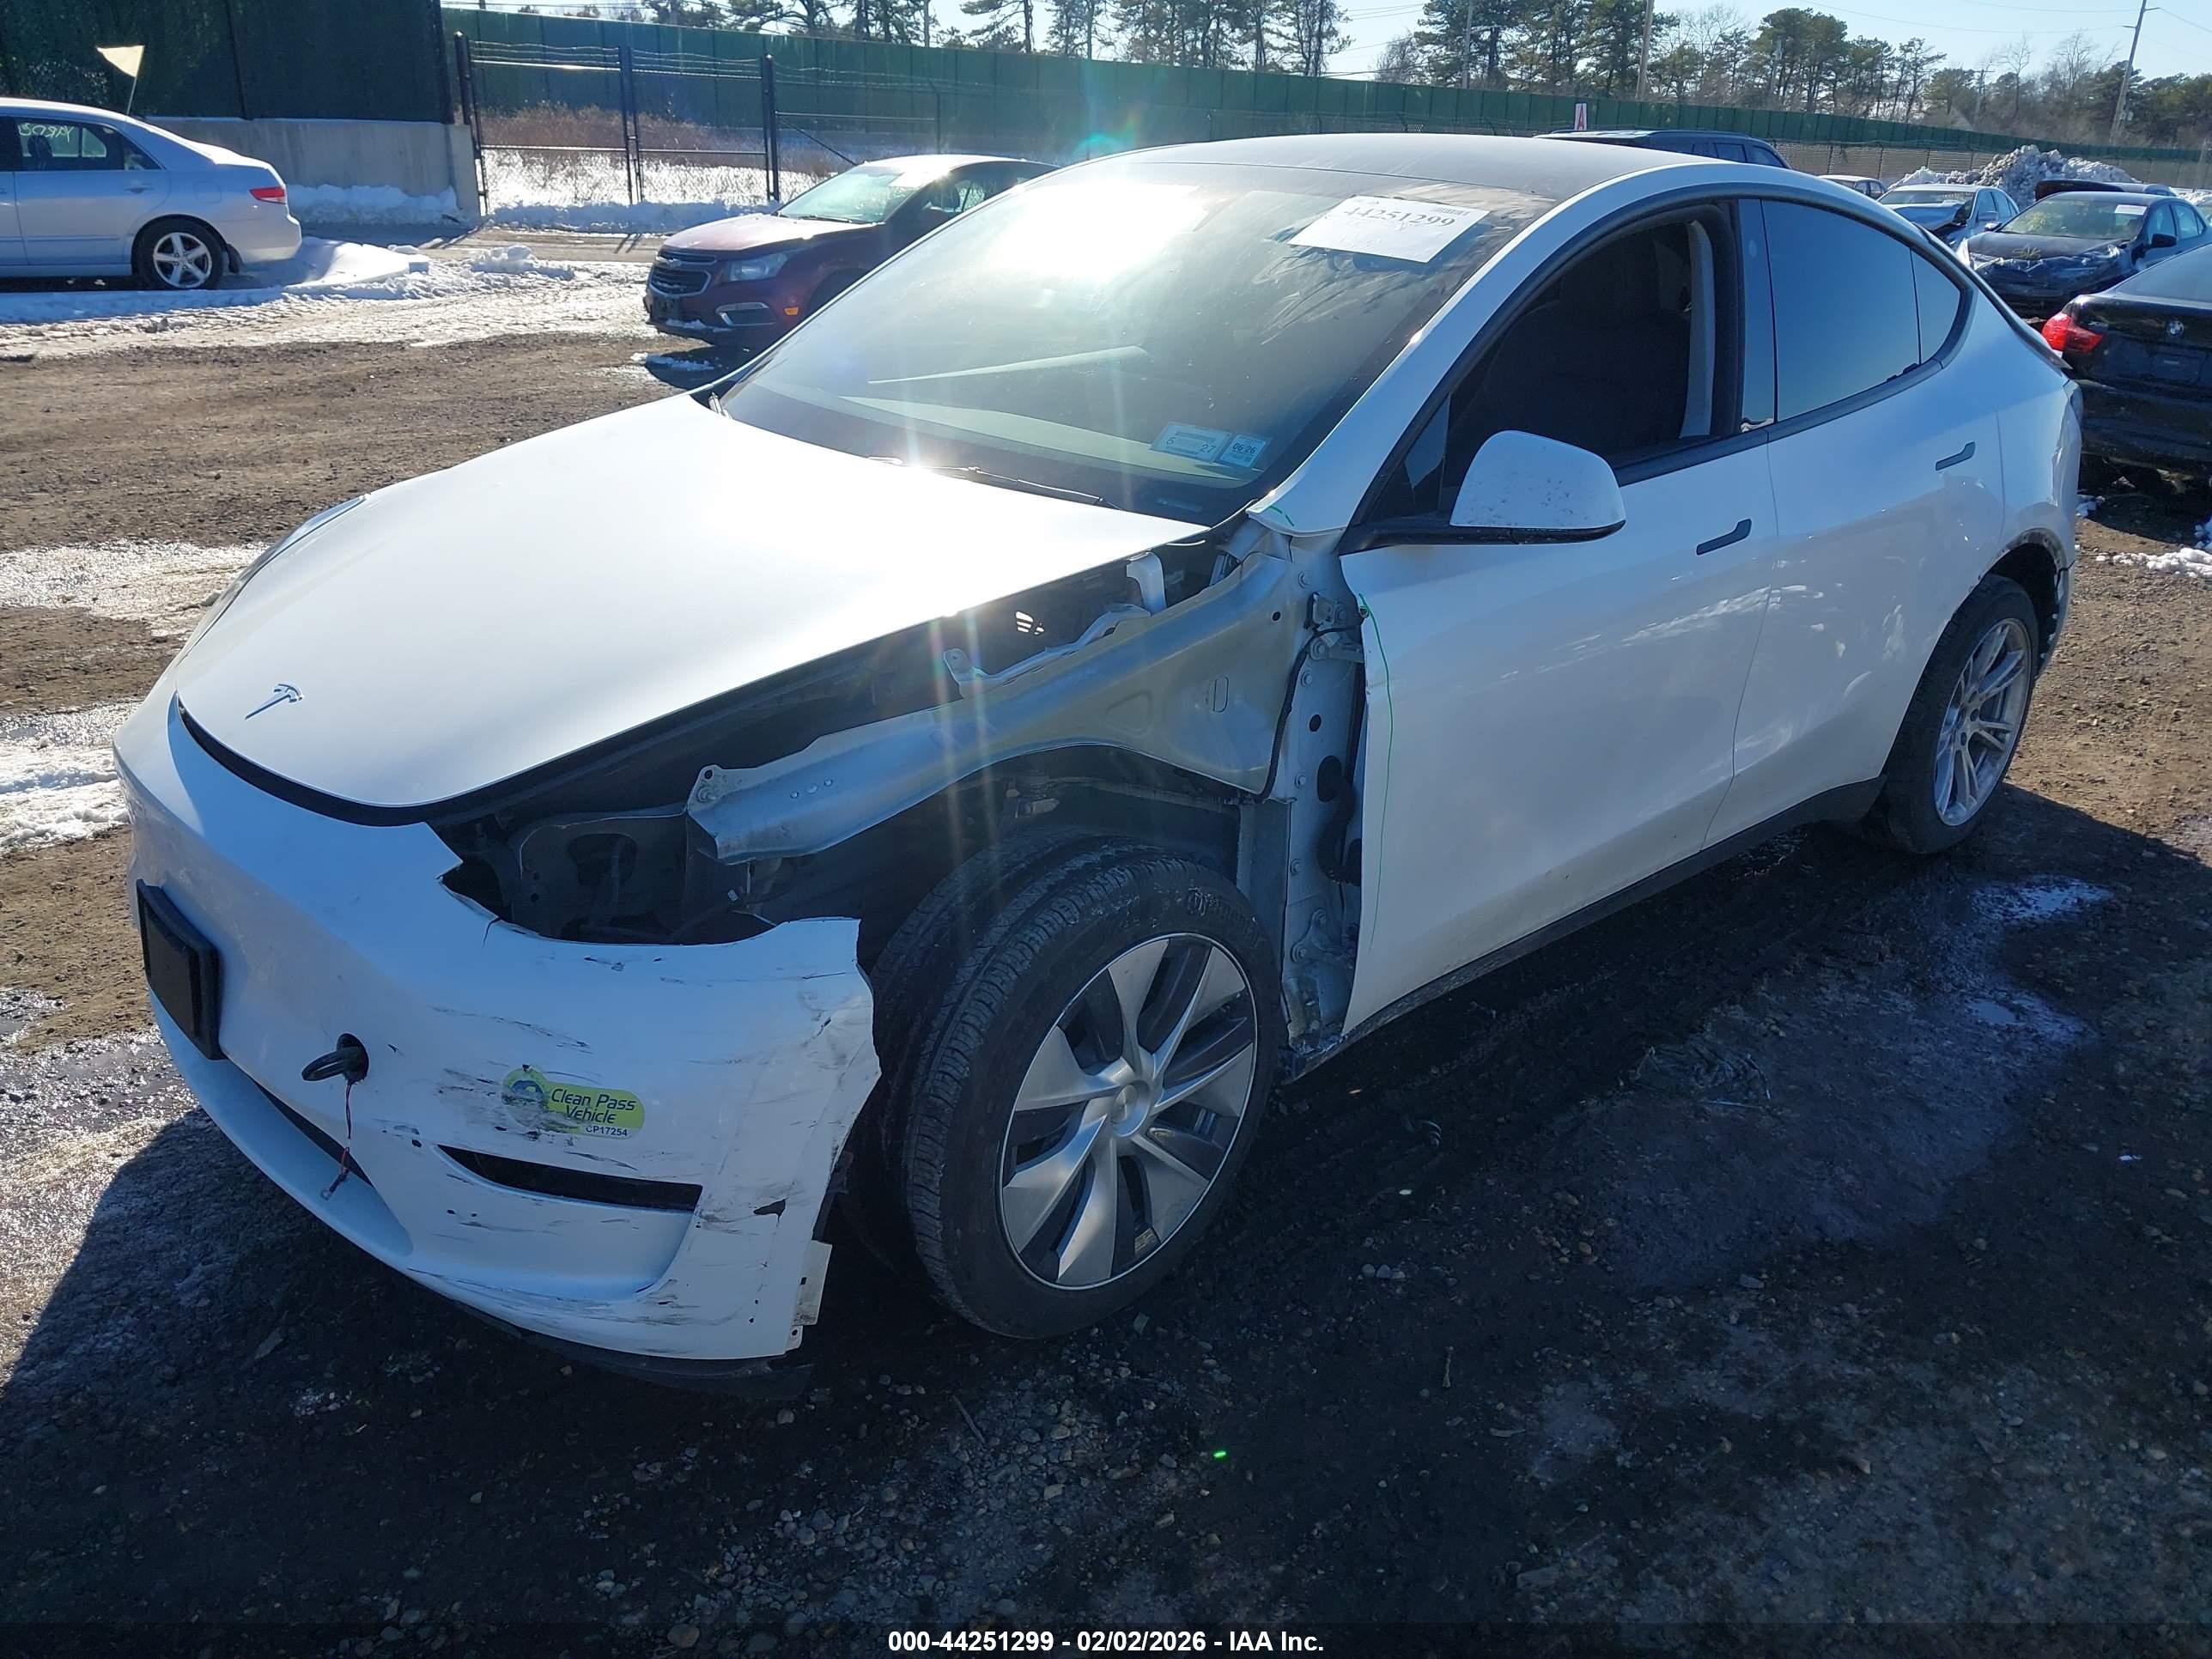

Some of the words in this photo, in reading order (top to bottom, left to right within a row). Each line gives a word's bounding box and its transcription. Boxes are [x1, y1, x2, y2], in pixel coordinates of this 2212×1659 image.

[1345, 207, 1455, 227] 44251299
[1200, 445, 1216, 453] 27
[1244, 446, 1256, 455] 26
[551, 1089, 592, 1106] Clean
[596, 1094, 636, 1110] Pass
[566, 1105, 617, 1124] Vehicle
[586, 1126, 628, 1136] CP17254
